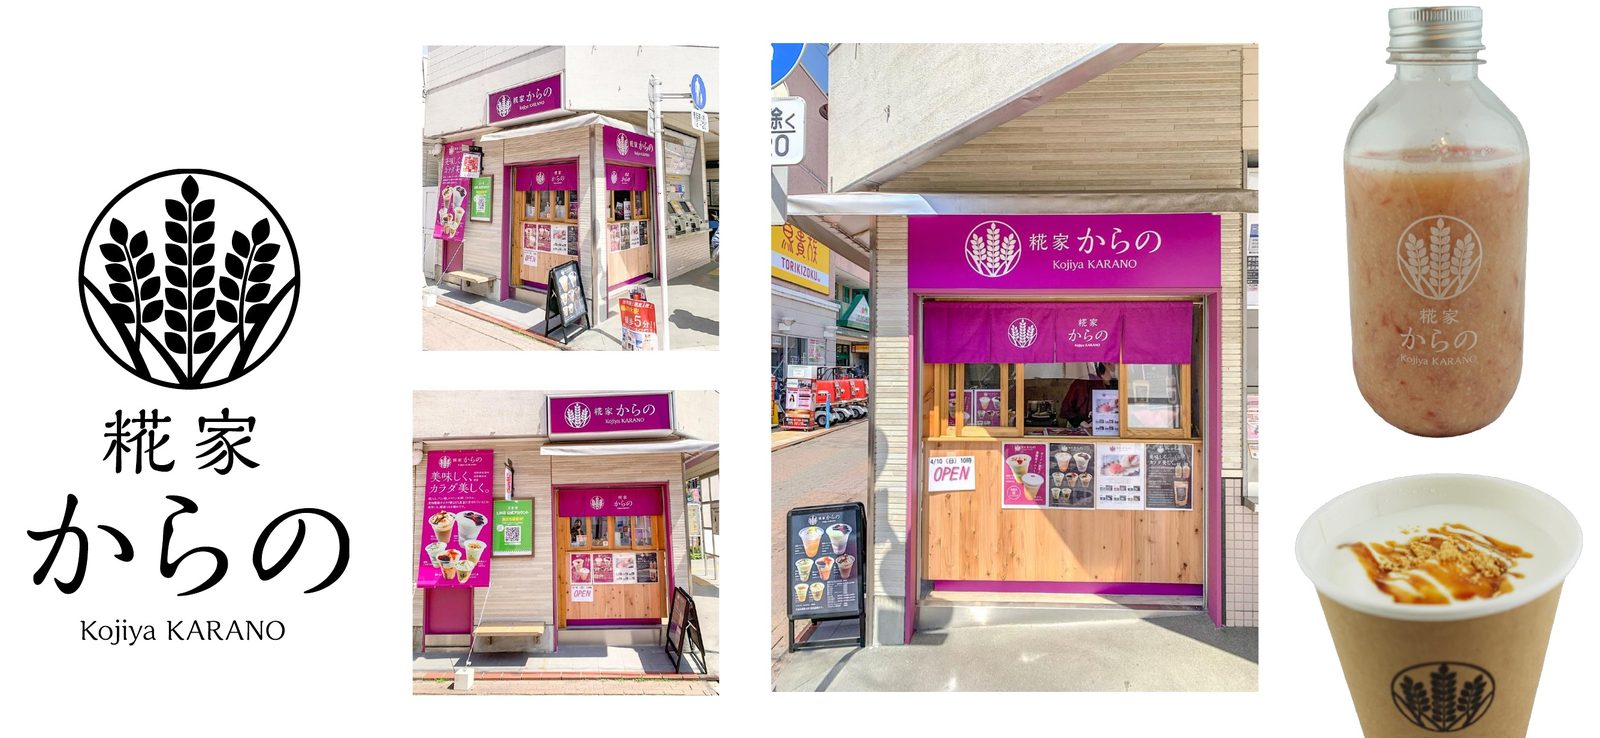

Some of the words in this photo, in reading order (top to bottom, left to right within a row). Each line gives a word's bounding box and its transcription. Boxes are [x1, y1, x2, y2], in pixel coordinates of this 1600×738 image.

[526, 86, 552, 102] からの
[771, 134, 789, 157] 0
[1028, 232, 1070, 251] 糀家
[1076, 226, 1162, 255] からの
[781, 256, 818, 281] TORIKIZOKU
[1052, 259, 1084, 271] Kojiya
[1087, 259, 1137, 270] KARANO
[1419, 308, 1459, 325] 糀家
[1068, 328, 1109, 342] からの
[1400, 326, 1478, 353] からの
[1400, 353, 1428, 367] Kojiya
[1431, 354, 1478, 366] KARANO
[616, 403, 656, 417] からの
[430, 471, 473, 483] 美味しく、
[933, 465, 970, 482] OPEN
[429, 482, 490, 494] カラダ美しく。
[573, 589, 592, 598] OPEN
